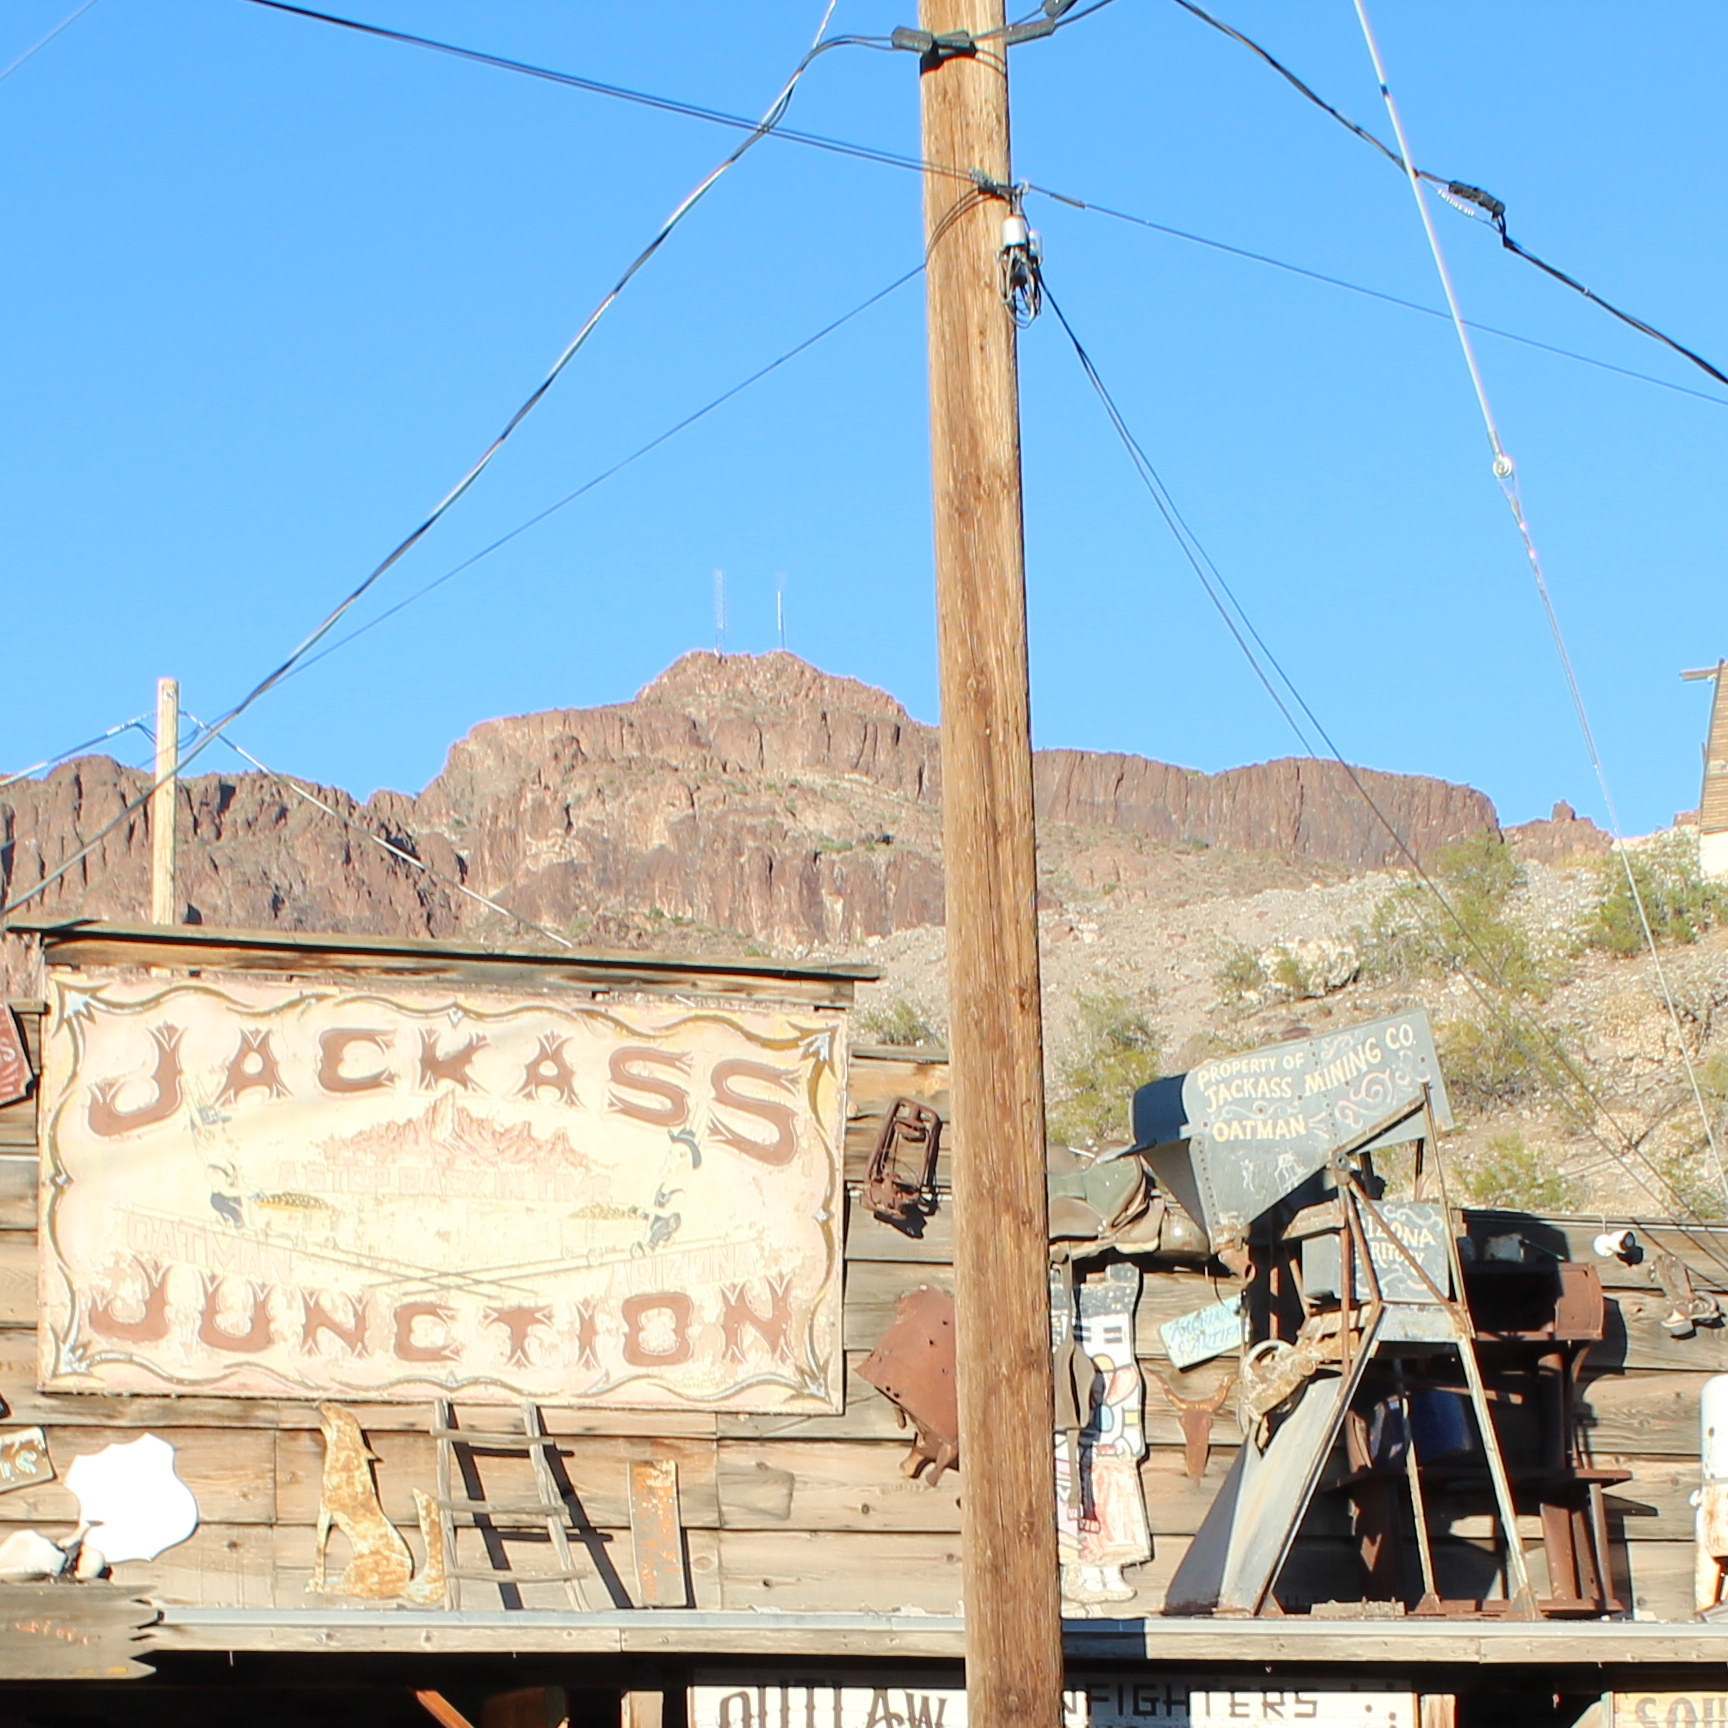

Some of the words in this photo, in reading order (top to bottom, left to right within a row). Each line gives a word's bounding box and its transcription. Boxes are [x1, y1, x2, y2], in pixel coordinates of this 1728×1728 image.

[87, 1023, 803, 1166] JACKASS
[1196, 1056, 1277, 1092] PROPERTY
[1282, 1051, 1305, 1071] OF
[1203, 1075, 1293, 1114] JACKASS
[1303, 1036, 1382, 1098] MINING
[1385, 1023, 1417, 1051] CO.
[1212, 1113, 1308, 1143] OATMAN
[299, 1161, 392, 1195] STEP
[398, 1164, 481, 1199] BACK
[485, 1170, 523, 1200] IN
[531, 1170, 613, 1204] TIME
[126, 1218, 295, 1285] OATMAN
[609, 1242, 761, 1290] ARIZONA
[88, 1261, 794, 1371] JUNCTION
